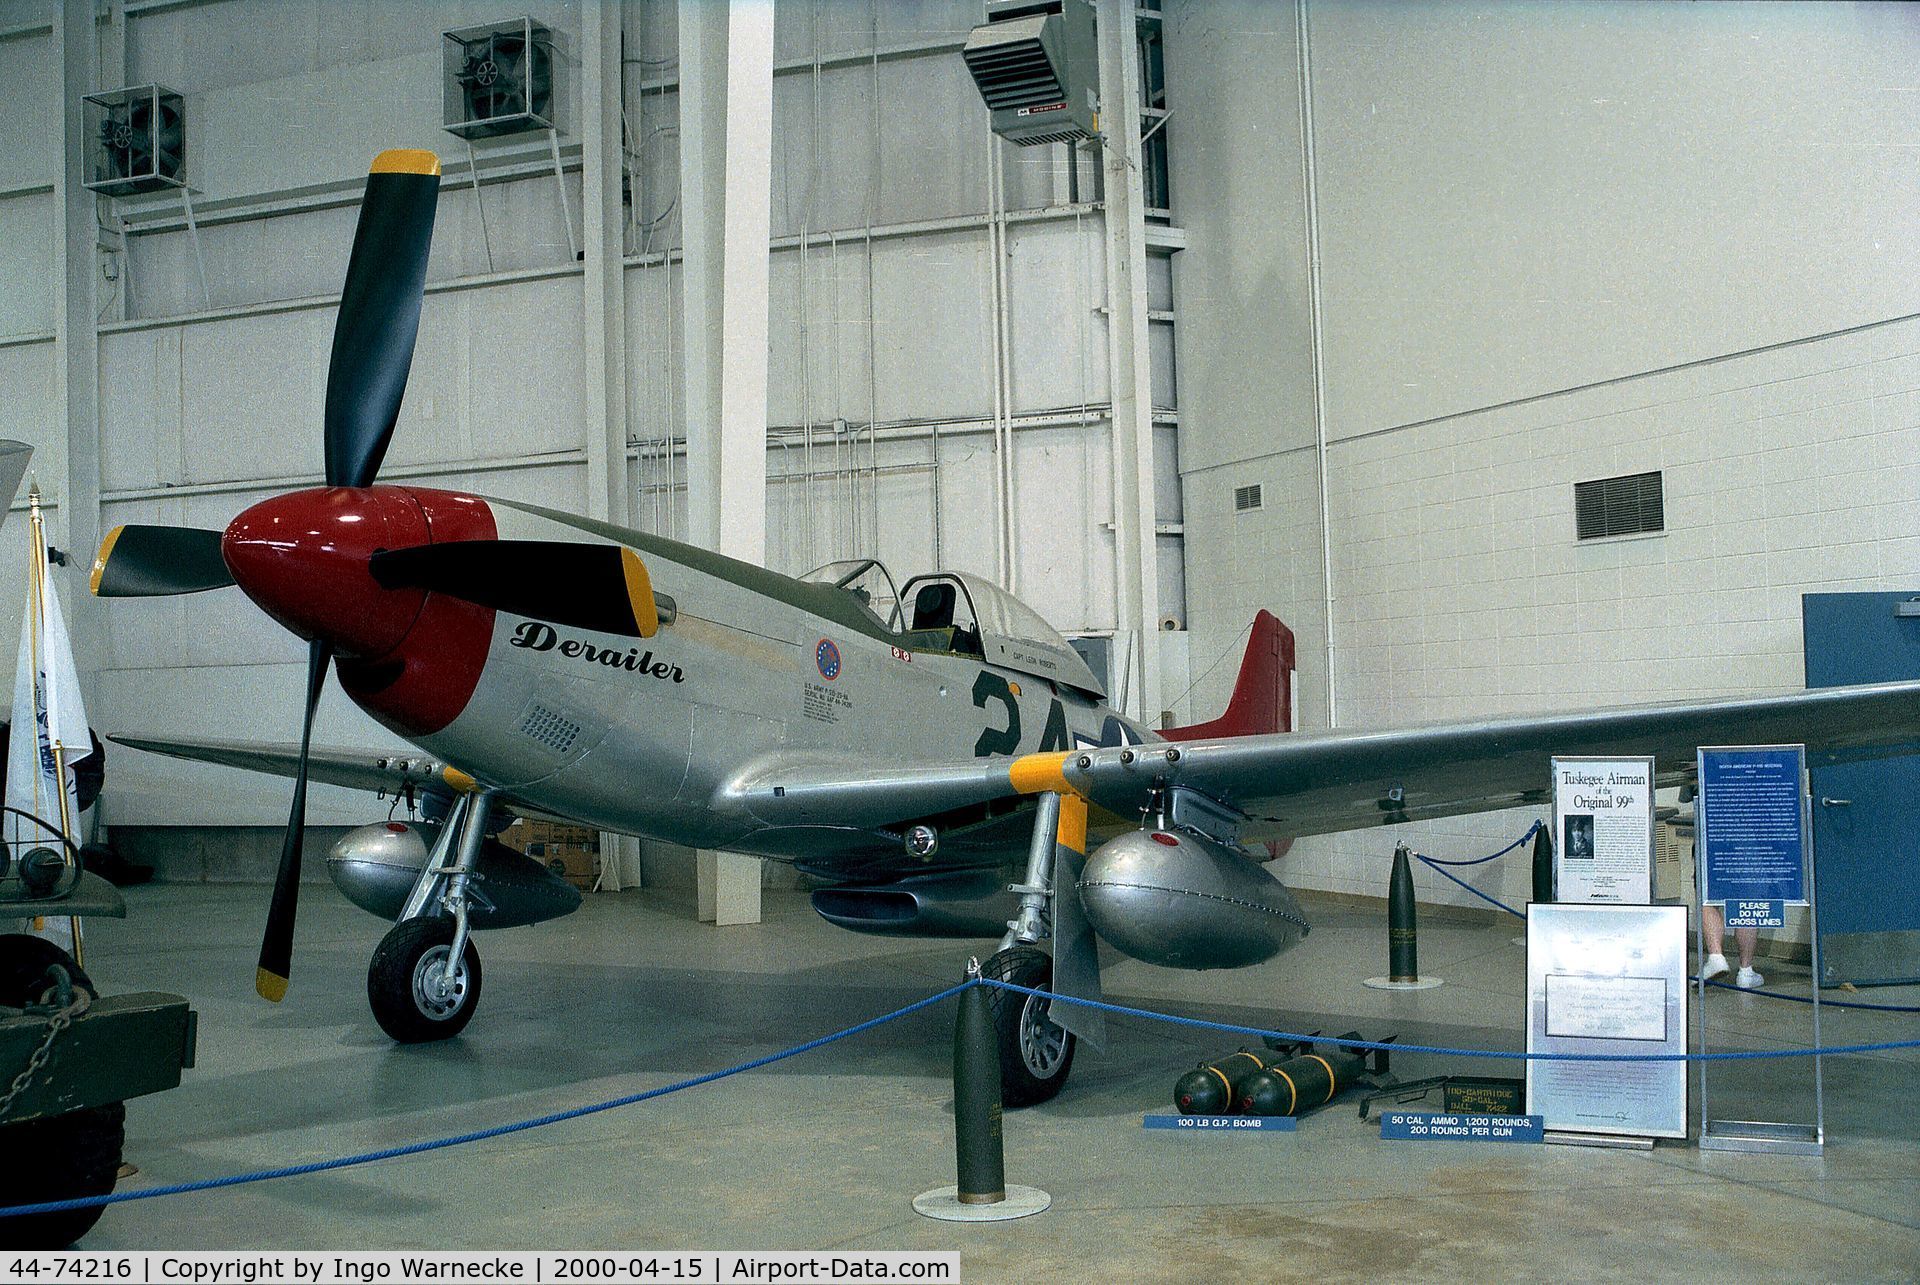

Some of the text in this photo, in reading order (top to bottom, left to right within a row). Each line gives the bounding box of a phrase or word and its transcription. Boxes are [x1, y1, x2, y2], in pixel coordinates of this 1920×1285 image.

[509, 621, 685, 684] Derailer
[1562, 771, 1645, 787] Tuskegee Airman
[1573, 795, 1612, 811] Original
[1739, 902, 1770, 910] PLEASE
[1739, 910, 1770, 918] DO NOT
[1729, 918, 1781, 926] CROSS LINES
[1178, 1119, 1262, 1127] 100 LB G.P. BOMB
[1391, 1115, 1533, 1129] 50 CAL AMMO 1,200 ROUNDS,
[1410, 1126, 1512, 1136] 200 ROUNDS PER GUN
